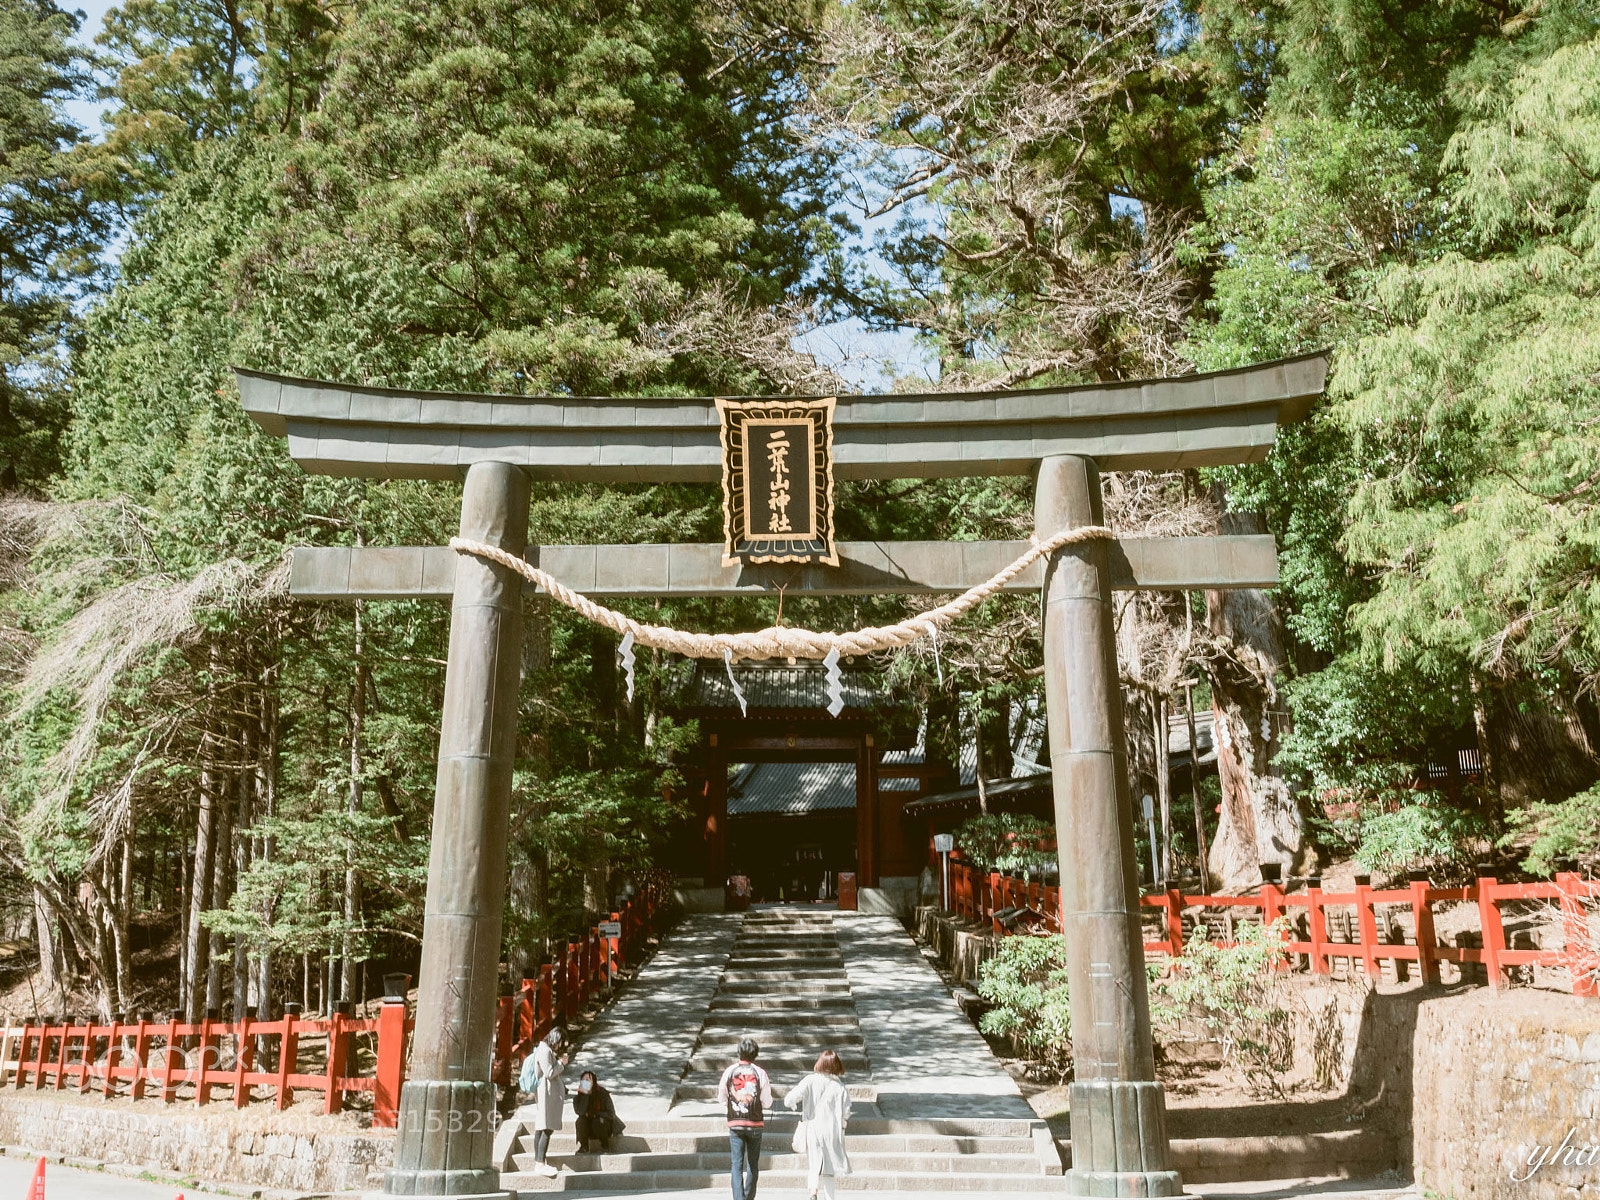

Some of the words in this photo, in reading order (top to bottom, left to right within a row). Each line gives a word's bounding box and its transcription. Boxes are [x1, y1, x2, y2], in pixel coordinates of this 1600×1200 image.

[766, 430, 792, 533] 二荒山神社
